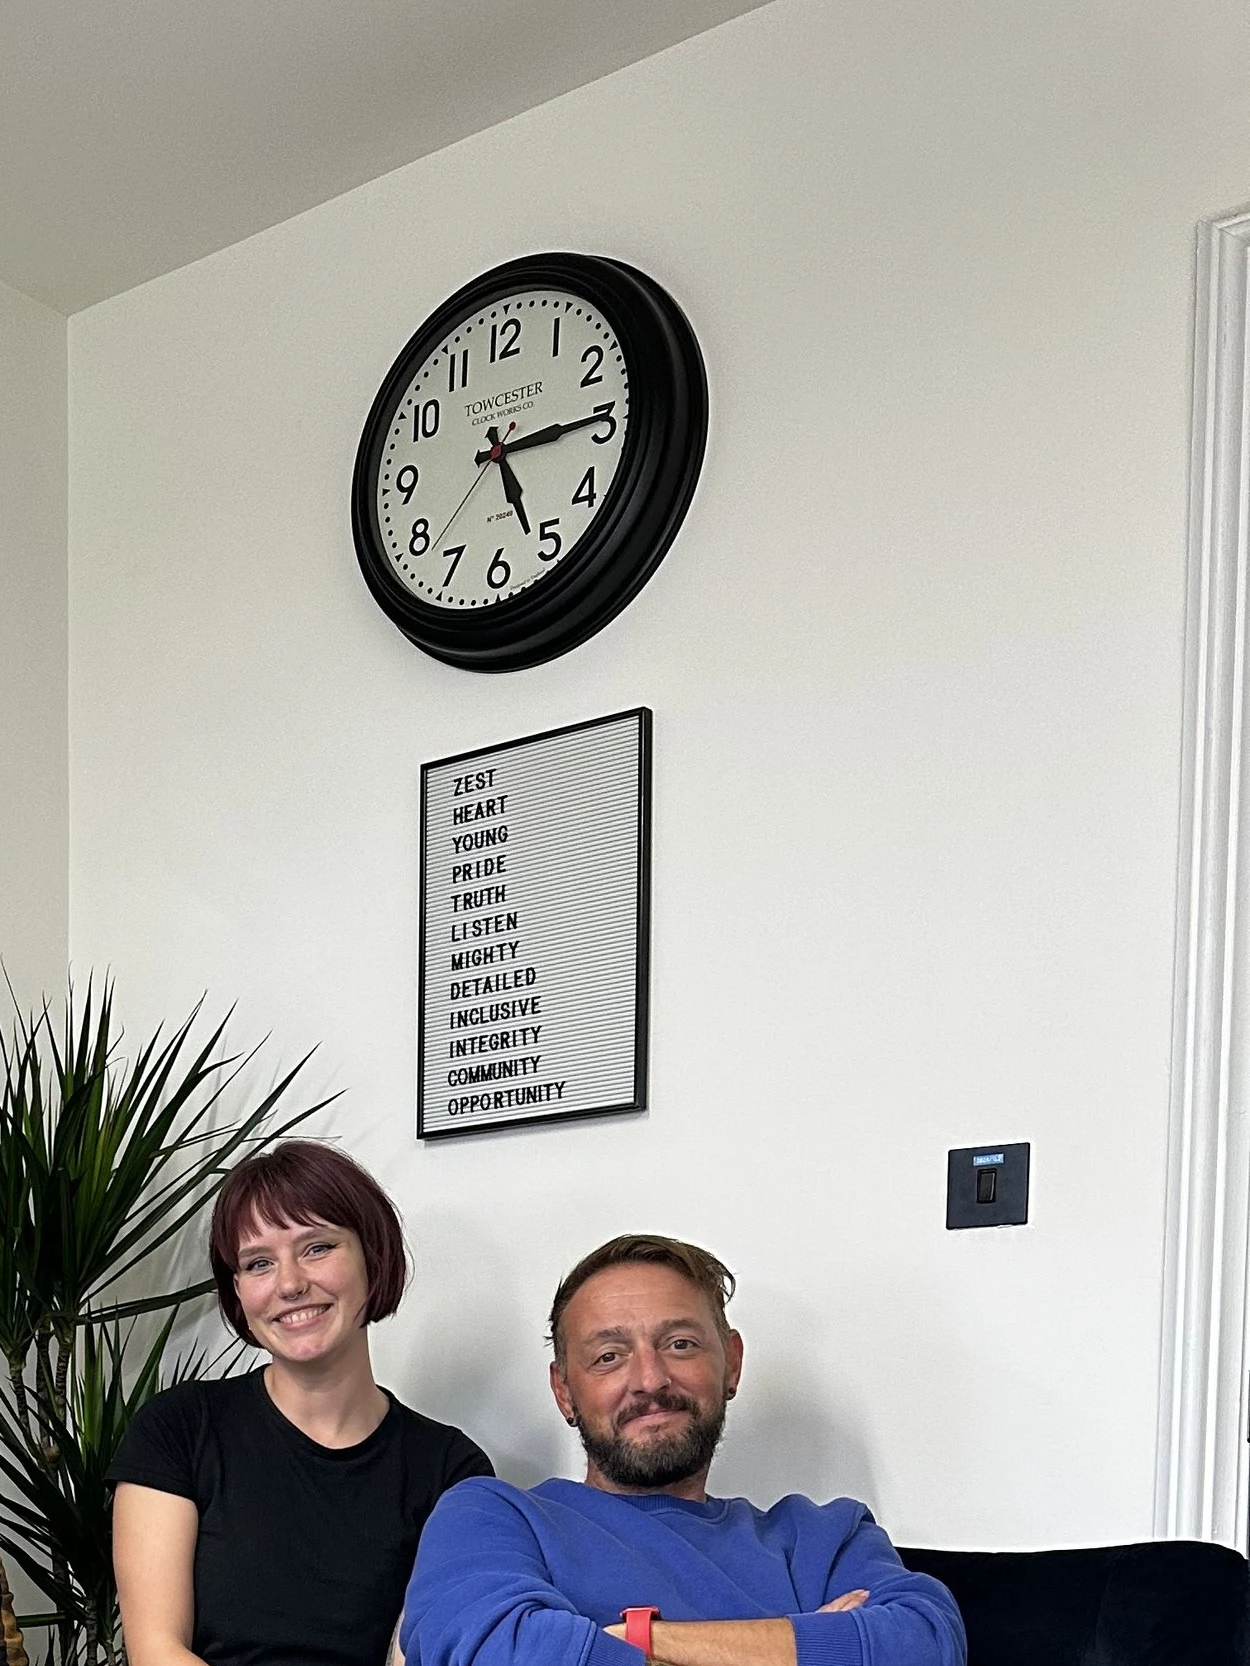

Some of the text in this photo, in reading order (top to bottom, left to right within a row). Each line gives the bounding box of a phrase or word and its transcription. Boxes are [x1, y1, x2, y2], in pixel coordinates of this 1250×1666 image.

[490, 317, 522, 363] 12
[552, 316, 561, 358] 1
[448, 346, 469, 393] 11
[579, 344, 604, 388] 2
[464, 381, 543, 417] TOWCESTER
[471, 413, 496, 426] CLOCK
[497, 404, 522, 418] WORKS
[411, 399, 440, 443] 10
[591, 401, 618, 445] 3
[396, 464, 419, 506] 9
[572, 465, 597, 509] 4
[408, 518, 431, 557] 8
[537, 518, 562, 562] 5
[442, 544, 467, 588] 7
[486, 547, 512, 590] 6
[453, 769, 497, 796] ZEST
[453, 795, 509, 825] HEART
[452, 825, 508, 854] YOUNG
[452, 855, 507, 884] PRIDE
[450, 884, 506, 912] TRUTH
[451, 912, 518, 942] LISTEN
[451, 941, 520, 971] MIGHTY
[450, 967, 536, 1000] DETAILED
[450, 996, 542, 1029] INCLUSIVE
[449, 1025, 543, 1058] INTEGRITY
[447, 1055, 542, 1087] COMMUNITY
[447, 1081, 566, 1116] OPPORTUNITY
